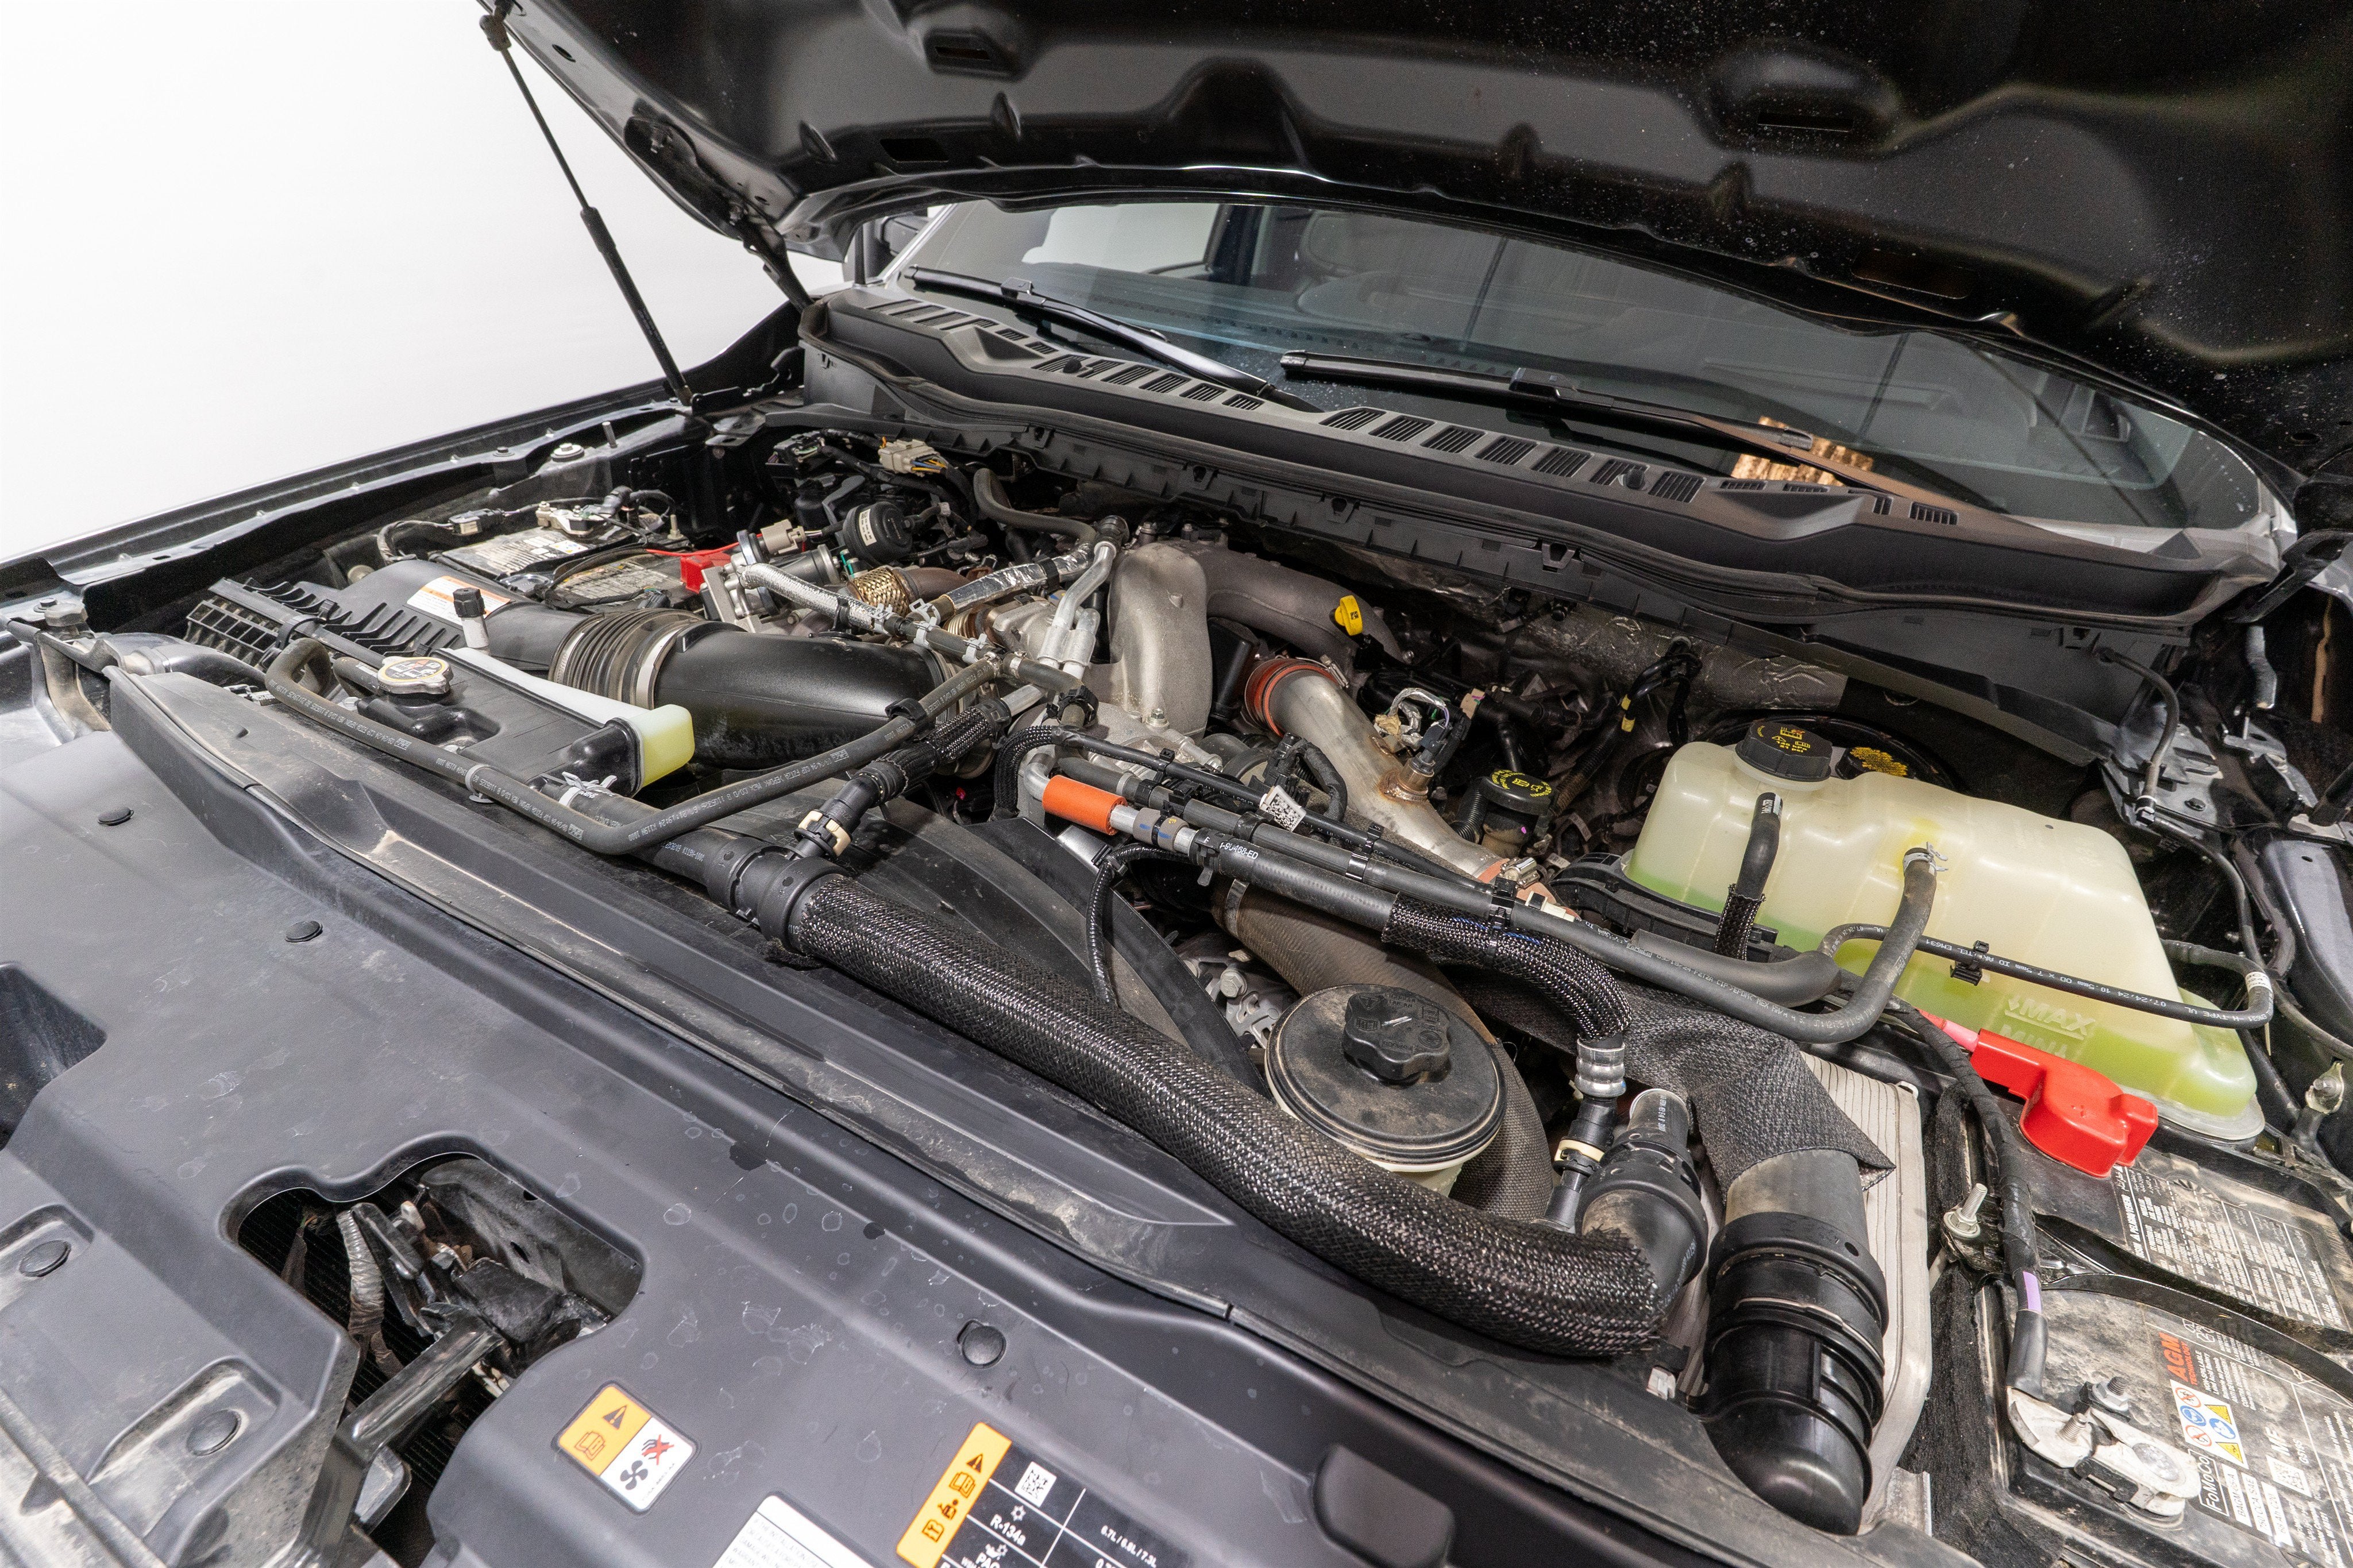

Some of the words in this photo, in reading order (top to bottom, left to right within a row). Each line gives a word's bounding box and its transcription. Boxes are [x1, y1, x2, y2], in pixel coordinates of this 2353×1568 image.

[2058, 975, 2072, 984] OD
[2019, 998, 2095, 1033] MAX
[2183, 1006, 2197, 1014] UL
[2157, 1331, 2190, 1382] AGM
[2178, 1339, 2199, 1387] TECHNOLOGY
[2202, 1351, 2214, 1370] Battery
[2193, 1349, 2212, 1392] NON-SPILLABLE
[2207, 1369, 2216, 1382] Acid
[2229, 1390, 2238, 1403] ANTI
[2238, 1387, 2249, 1408] CONTRA
[2265, 1426, 2290, 1457] MF
[2196, 1454, 2222, 1511] FoMoCo
[2245, 1476, 2258, 1496] SAE
[2251, 1495, 2265, 1516] CCA
[2266, 1492, 2279, 1509] C20
[2273, 1509, 2282, 1522] Ah
[989, 1513, 1029, 1546] R-134a
[767, 1530, 808, 1561] INSTALLATION
[1099, 1524, 1120, 1542] 6.7L
[1139, 1550, 1160, 1568] 7.3L
